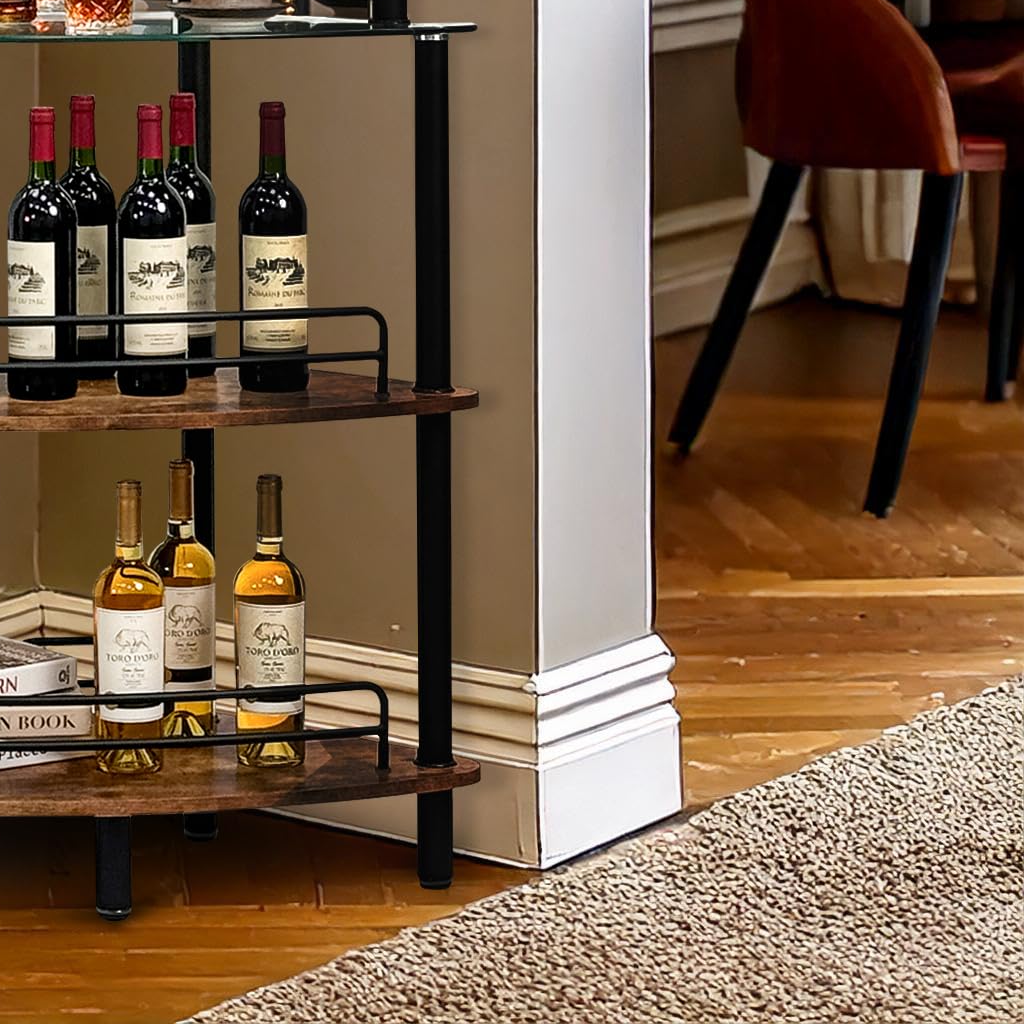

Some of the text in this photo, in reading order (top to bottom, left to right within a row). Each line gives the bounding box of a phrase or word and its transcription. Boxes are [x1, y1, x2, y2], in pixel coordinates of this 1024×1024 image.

[164, 628, 184, 638] ORO
[245, 646, 271, 656] TORO
[106, 652, 132, 663] TORO
[18, 714, 76, 730] BOOK
